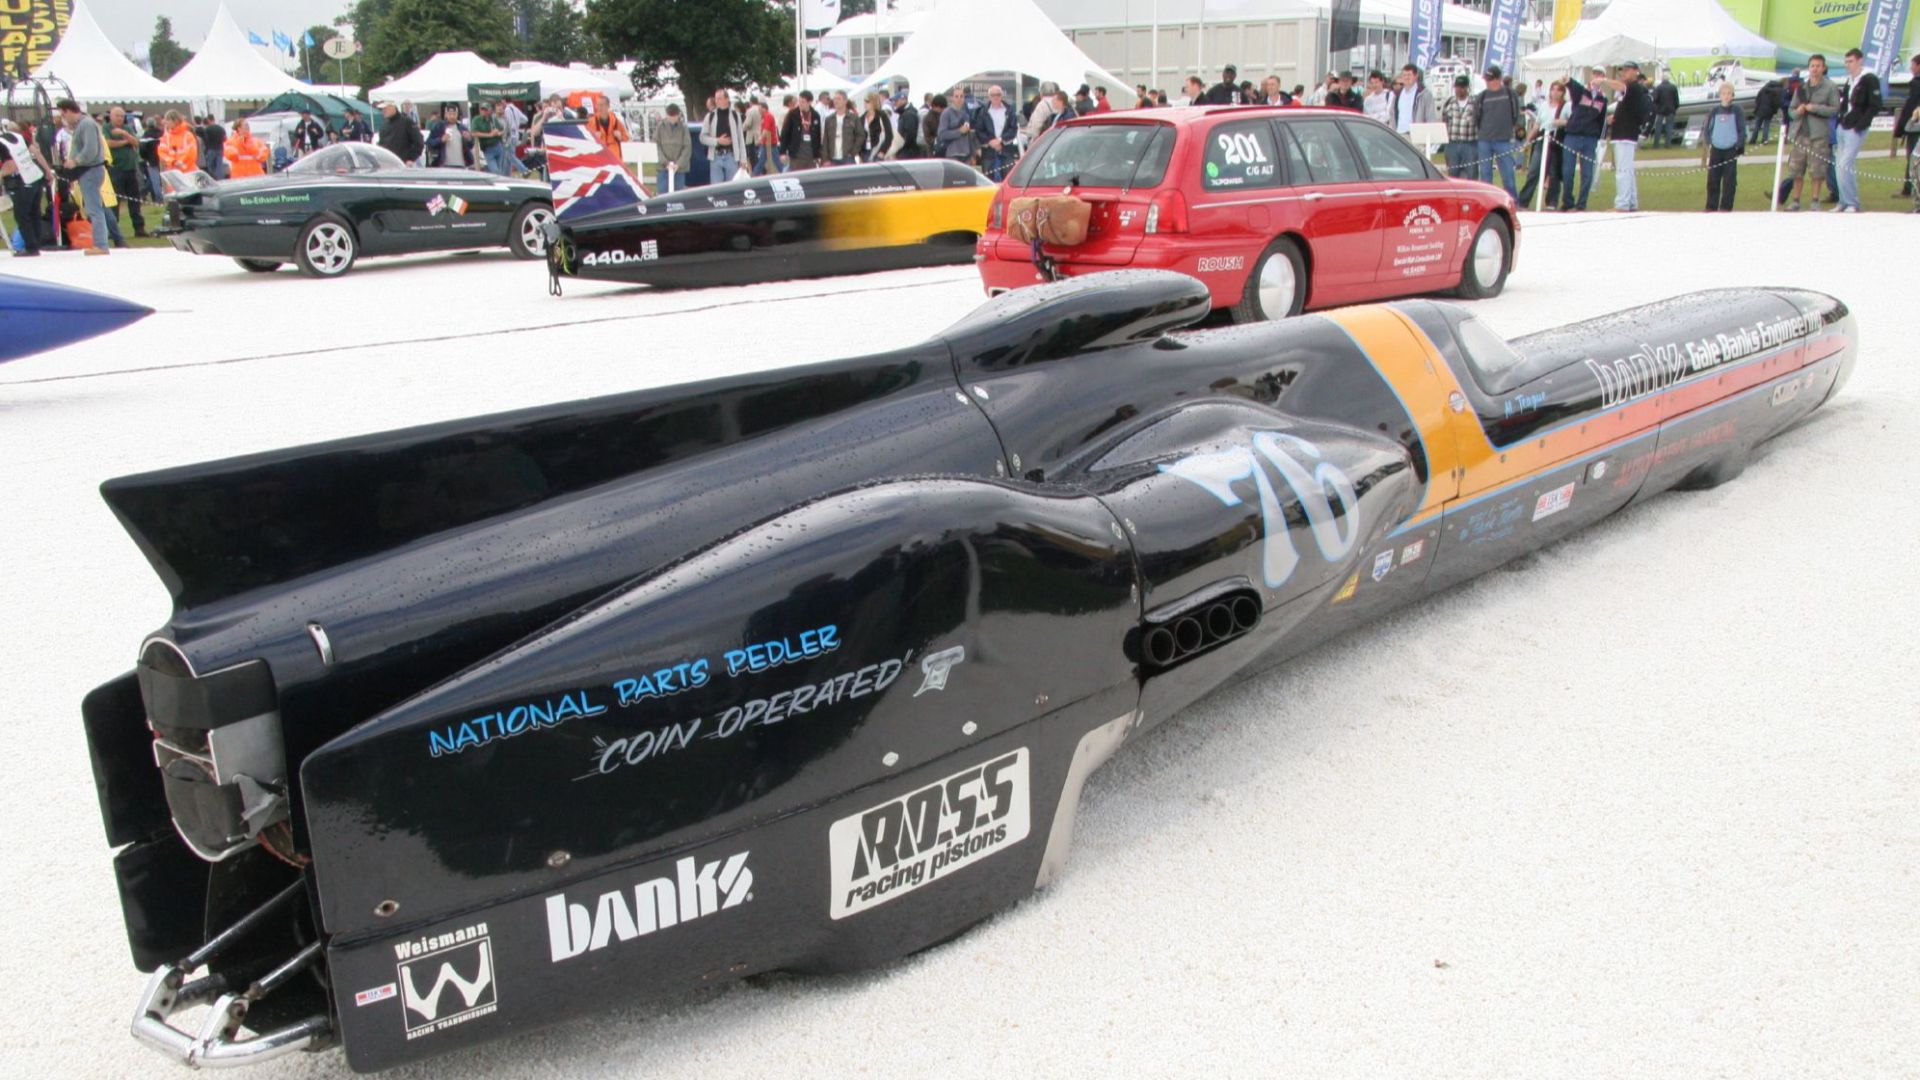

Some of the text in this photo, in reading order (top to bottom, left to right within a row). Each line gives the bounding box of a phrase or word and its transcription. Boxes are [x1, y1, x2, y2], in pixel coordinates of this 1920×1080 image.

[1218, 132, 1267, 165] 201
[1246, 164, 1274, 176] C/G ALT
[583, 249, 625, 266] 440
[1197, 256, 1244, 272] ROUSH
[1685, 341, 1725, 371] Gale
[1716, 327, 1760, 363] Banks
[1757, 307, 1823, 350] Engineering
[1157, 430, 1360, 588] 76
[429, 624, 841, 758] NATIONAL PARTS PEDLER
[851, 752, 1019, 882] ROSS
[845, 823, 1007, 908] racing pistons
[545, 851, 753, 963] banks
[395, 922, 488, 960] Weismann
[406, 1004, 498, 1041] RACING TRANSMISSIONS
